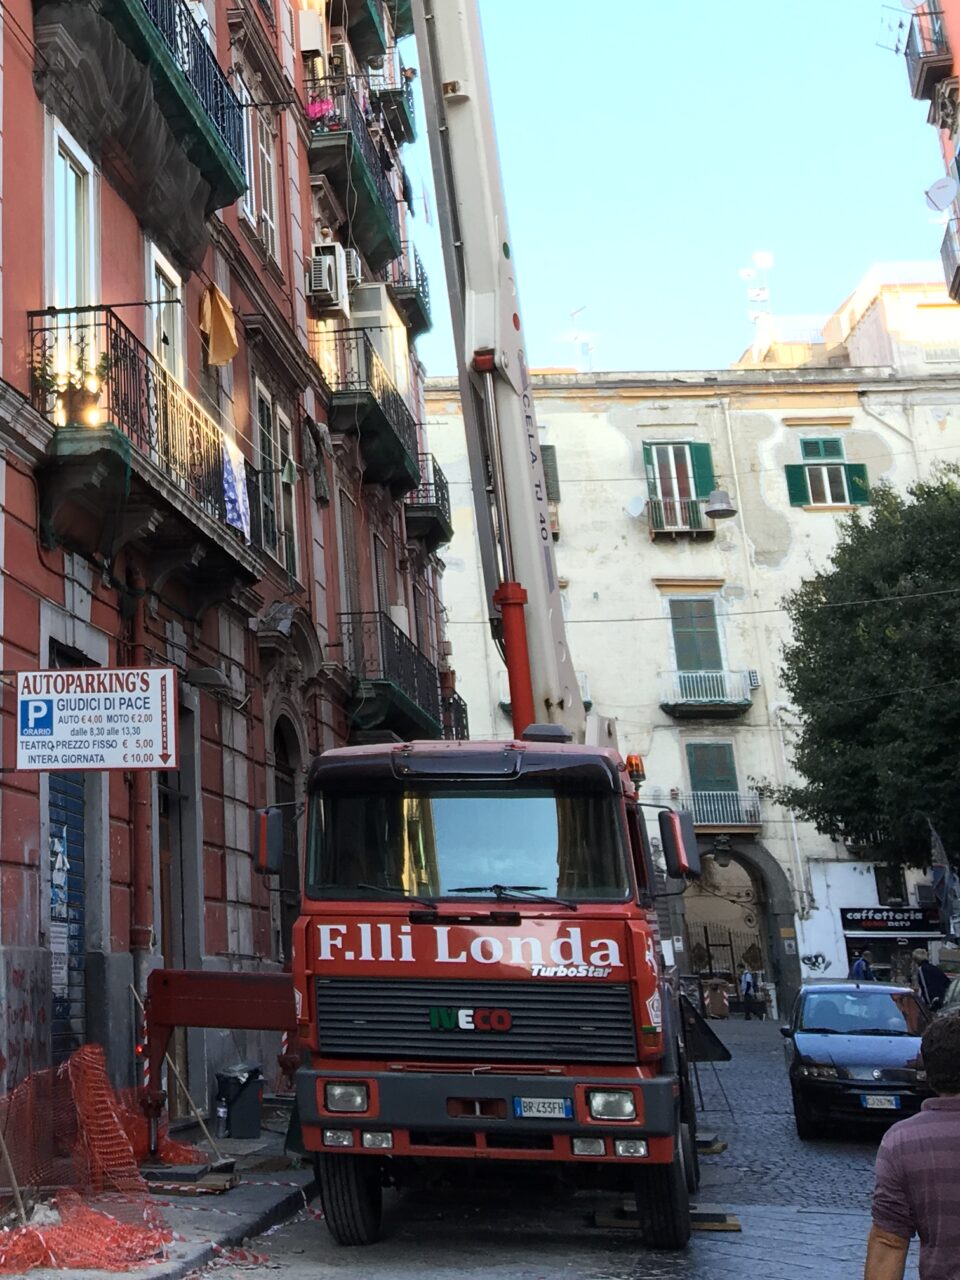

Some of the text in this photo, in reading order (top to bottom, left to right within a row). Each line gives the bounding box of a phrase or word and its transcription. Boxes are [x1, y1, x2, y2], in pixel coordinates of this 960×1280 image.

[534, 480, 543, 502] TJ
[539, 513, 549, 541] 40
[21, 671, 151, 695] AUTOPARKING'S
[56, 696, 151, 712] GIUDICI DI PACE
[28, 700, 48, 728] P
[58, 714, 153, 724] AUTO € 4,00 MOTO € 2,00
[23, 728, 52, 736] ORARIO
[70, 726, 141, 737] dalle 8,30 alle 13,30
[20, 739, 154, 751] TEATRO PREZZO FISSO € 5,00
[28, 753, 154, 764] INTERA GIORNATA € 10,00
[846, 910, 923, 920] caffetteria
[317, 923, 624, 967] F.lli Londa
[530, 965, 612, 978] TurboStar
[429, 1007, 513, 1031] IVECO
